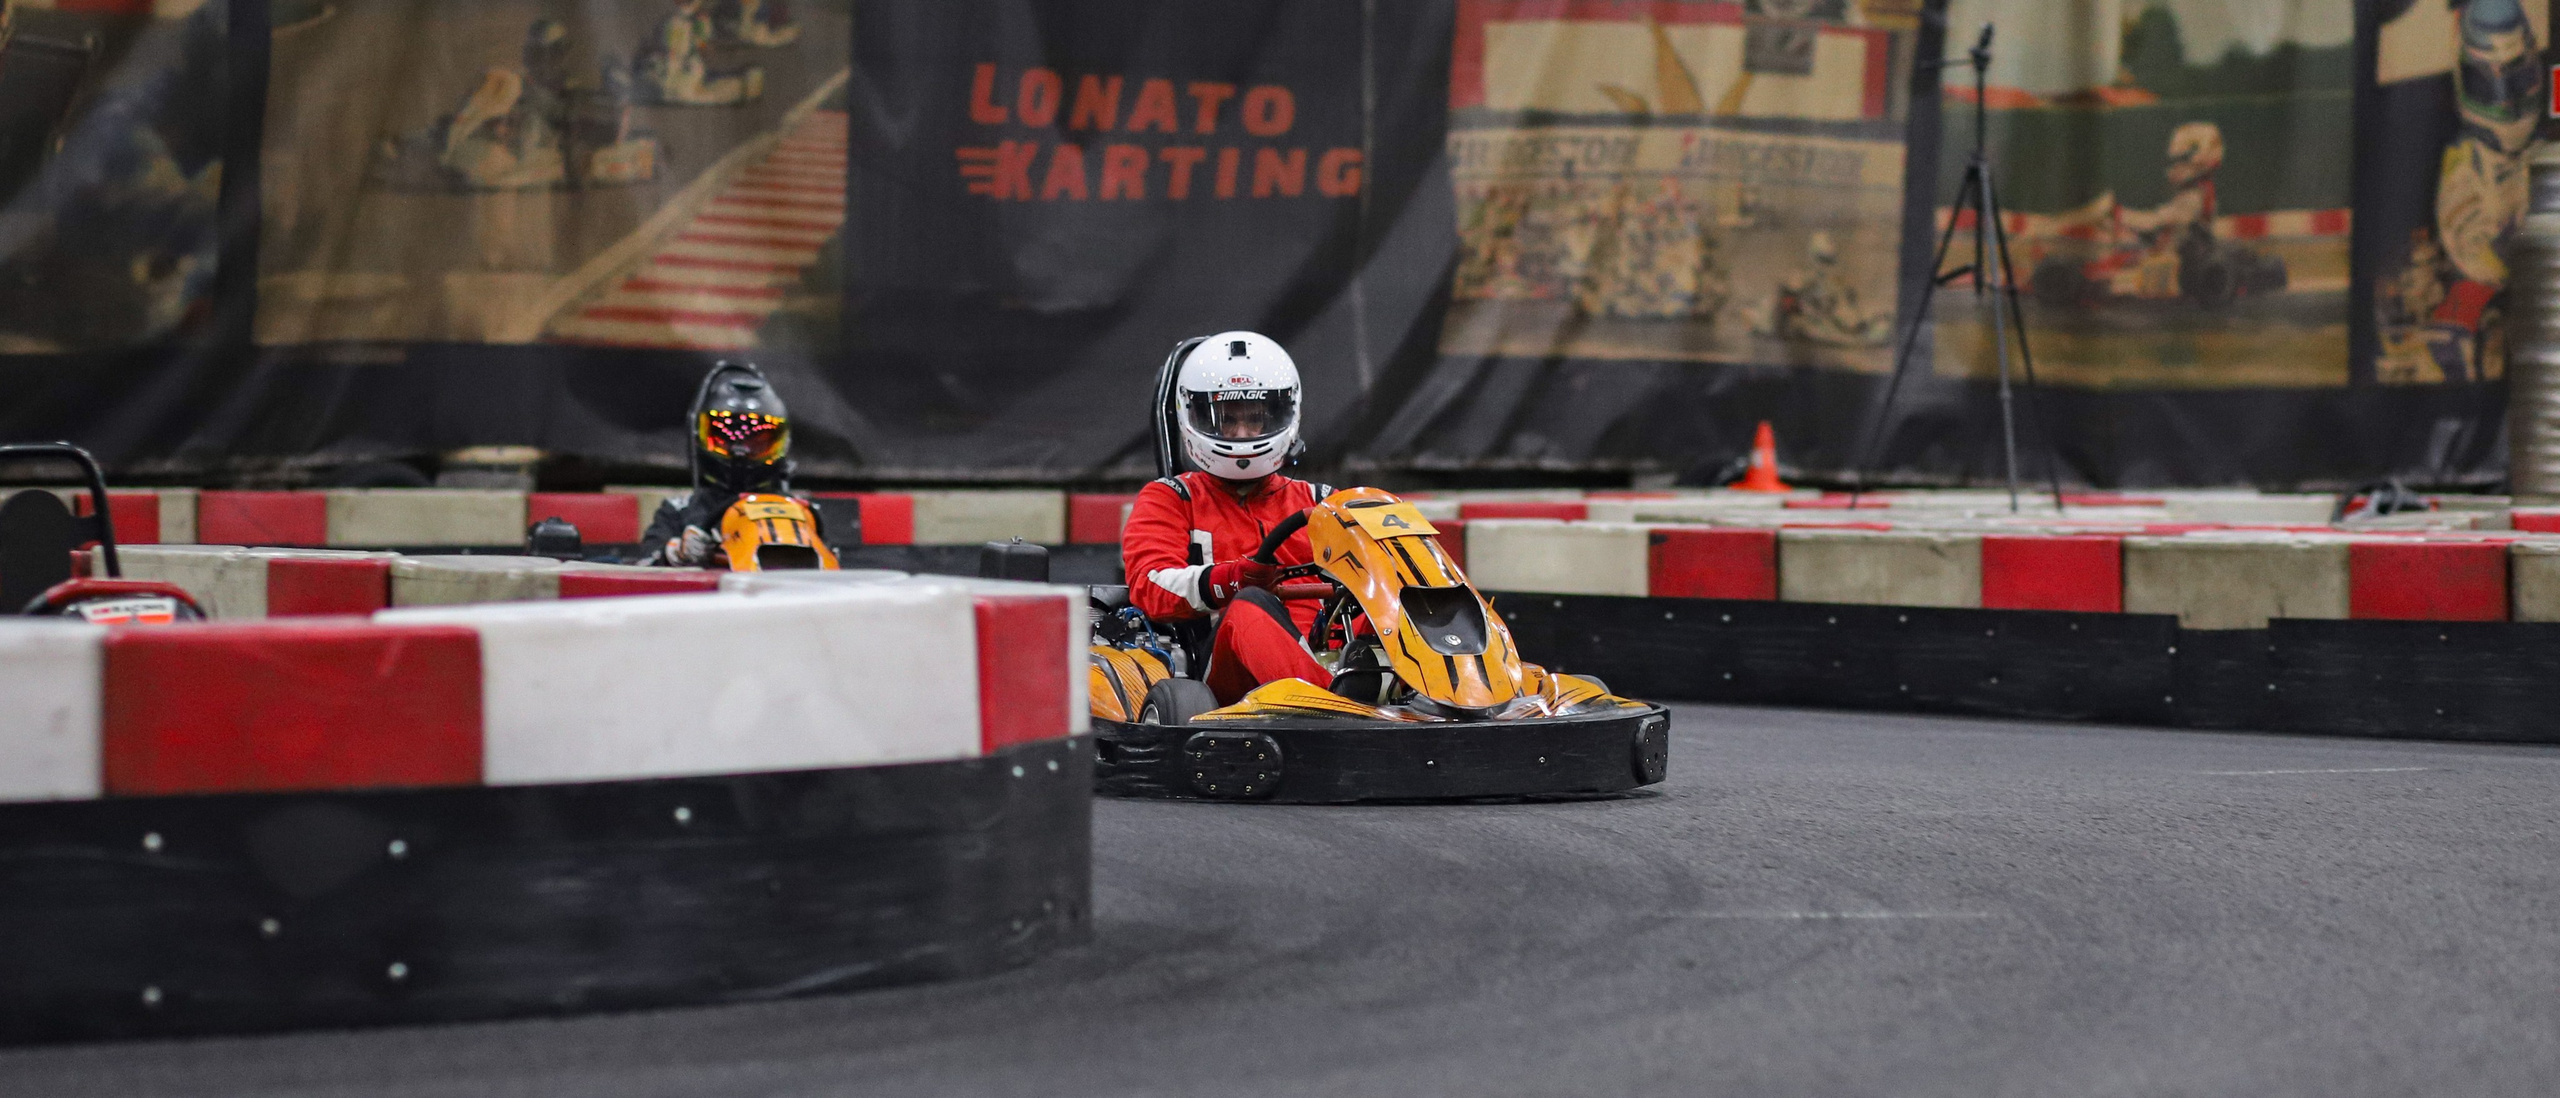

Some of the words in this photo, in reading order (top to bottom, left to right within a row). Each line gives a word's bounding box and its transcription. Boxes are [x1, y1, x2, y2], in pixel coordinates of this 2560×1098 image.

[969, 62, 1296, 137] LONATO
[957, 140, 1363, 200] KARTING
[1214, 390, 1269, 401] SIMAGIC
[1382, 514, 1410, 529] 4
